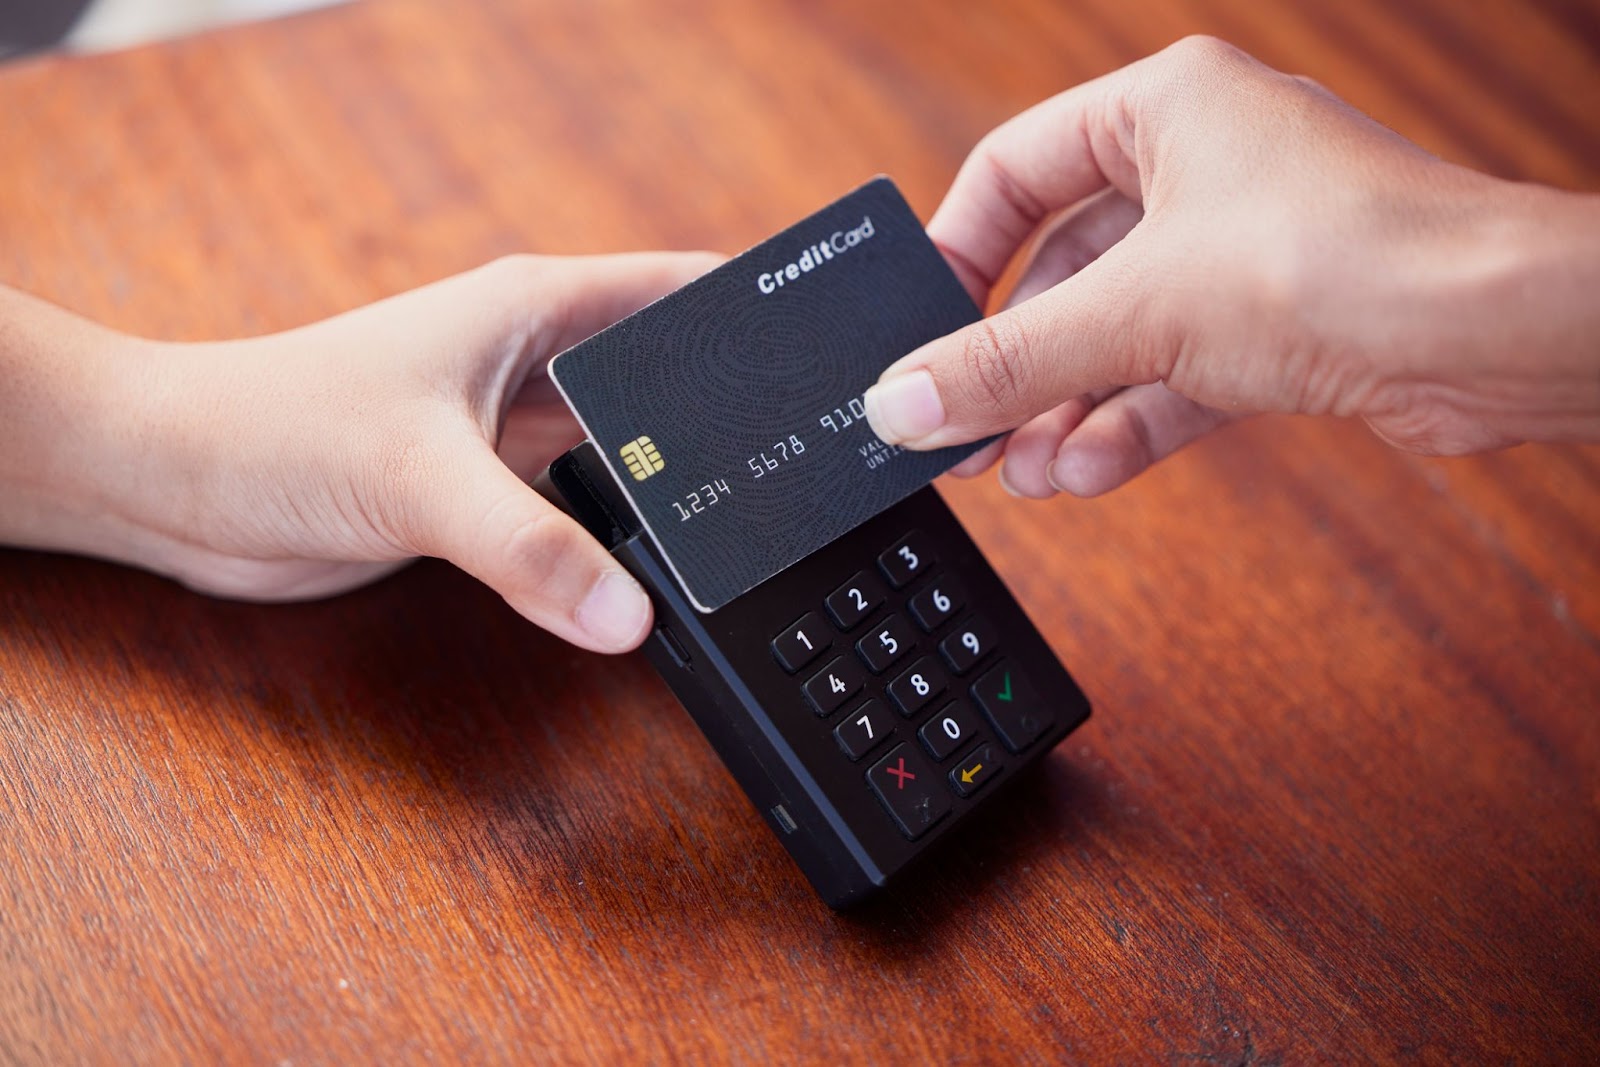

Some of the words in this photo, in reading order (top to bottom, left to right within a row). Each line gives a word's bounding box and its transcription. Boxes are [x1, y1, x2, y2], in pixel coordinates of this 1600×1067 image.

[671, 478, 732, 522] 1234
[747, 434, 806, 479] 5678
[819, 392, 867, 433] 910
[858, 439, 884, 458] VAL
[796, 630, 814, 651] 1
[848, 588, 869, 611] 2
[898, 545, 919, 570] 3
[828, 673, 846, 694] 4
[878, 630, 898, 654] 5
[932, 589, 951, 612] 6
[856, 714, 874, 739] 7
[910, 673, 930, 696] 8
[961, 631, 980, 655] 9
[942, 717, 961, 740] 0
